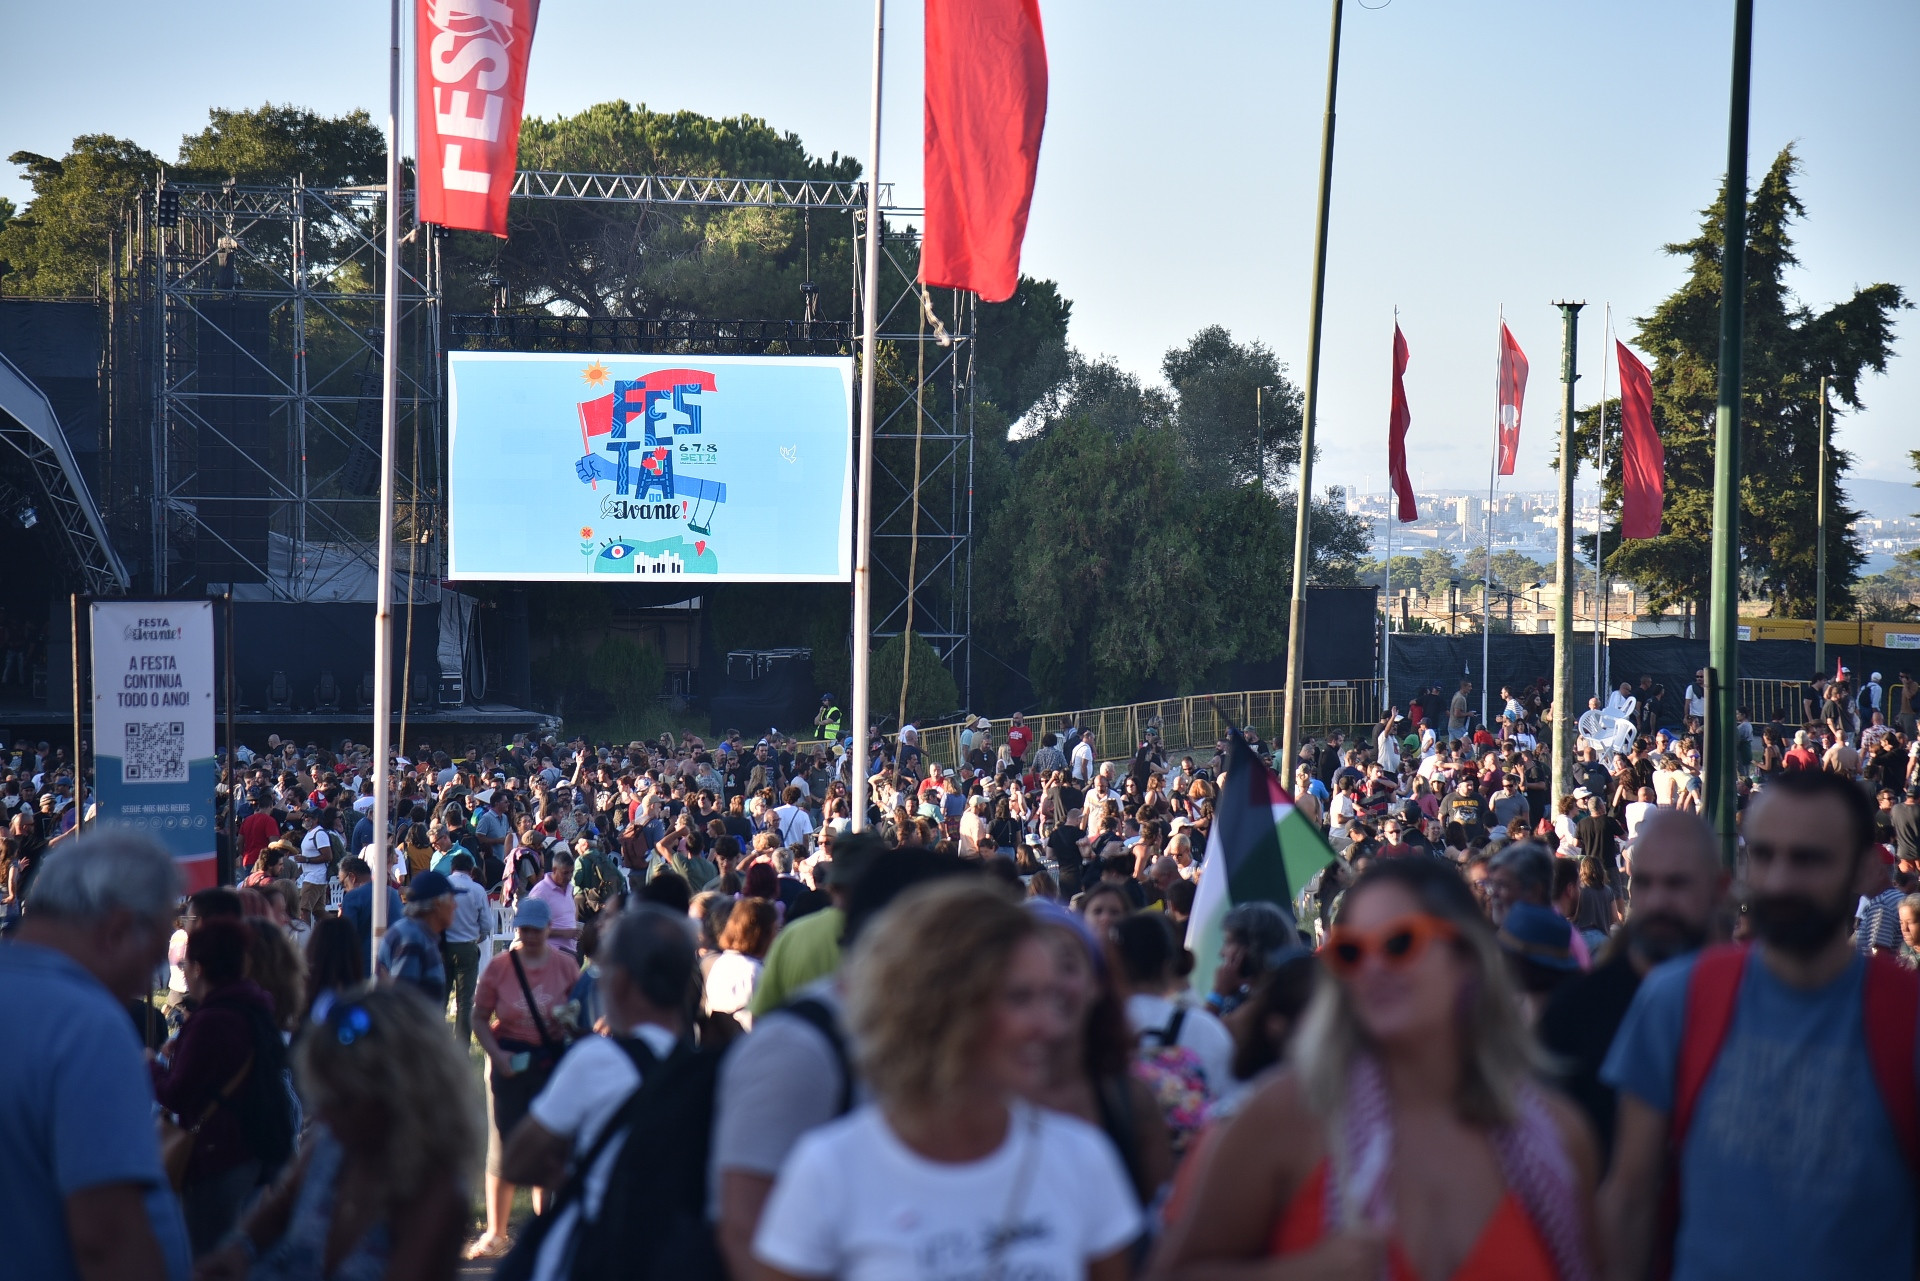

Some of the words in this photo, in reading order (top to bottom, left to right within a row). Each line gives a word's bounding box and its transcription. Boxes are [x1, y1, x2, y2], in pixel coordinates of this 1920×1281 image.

[611, 380, 702, 446] FES
[606, 441, 675, 499] TA
[138, 618, 171, 627] FESTA
[129, 656, 138, 670] A
[141, 656, 177, 670] FESTA
[124, 674, 182, 688] CONTINUA
[117, 692, 148, 707] TODO
[151, 692, 159, 707] O
[162, 691, 190, 706] ANO!
[170, 804, 190, 812] REDES
